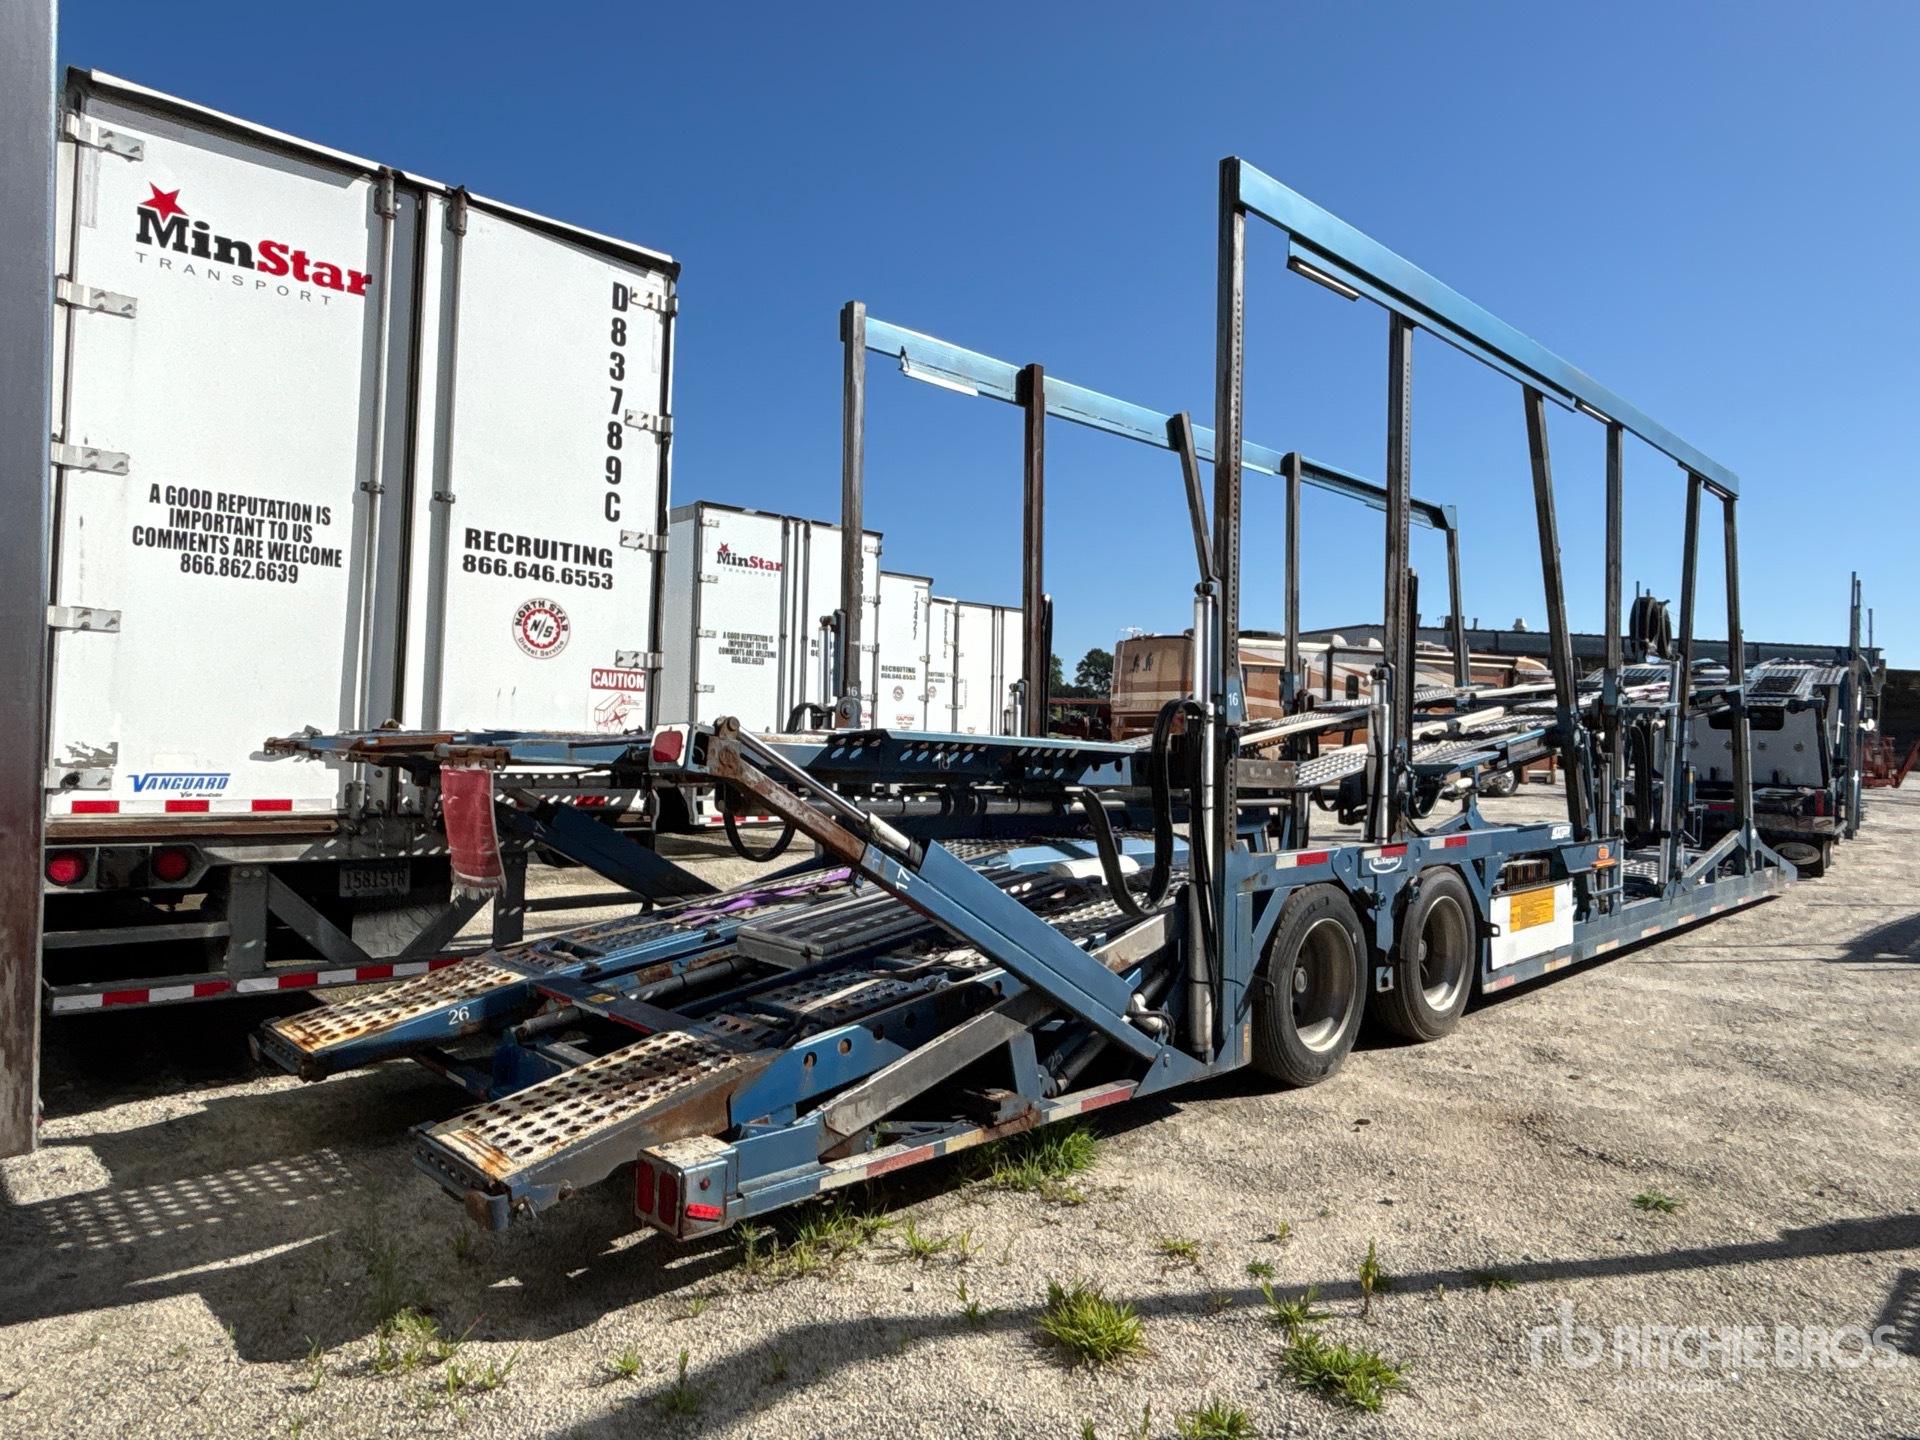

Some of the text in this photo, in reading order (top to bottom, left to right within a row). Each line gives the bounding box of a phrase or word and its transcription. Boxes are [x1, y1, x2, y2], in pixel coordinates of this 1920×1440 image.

[136, 205, 373, 296] MinStar
[135, 251, 332, 306] TRANSPORT
[604, 281, 629, 523] D83789C
[148, 483, 332, 526] A GOOD REPUTATION IS
[168, 507, 314, 544] IMPORTANT TO US
[131, 525, 343, 568] COMMENTS ARE WELCOME
[464, 527, 614, 569] RECRUITING
[716, 550, 785, 572] MinStar
[179, 552, 300, 584] 866.862.6639
[462, 554, 614, 590] 866.646.6553
[514, 600, 569, 632] NORTH STAR
[517, 636, 565, 657] Diesel Service
[592, 671, 645, 689] CAUTION
[846, 686, 858, 697] 16
[1228, 692, 1239, 706] 16
[127, 773, 231, 793] VANGUARD
[895, 867, 911, 890] 17
[448, 1006, 470, 1026] 26
